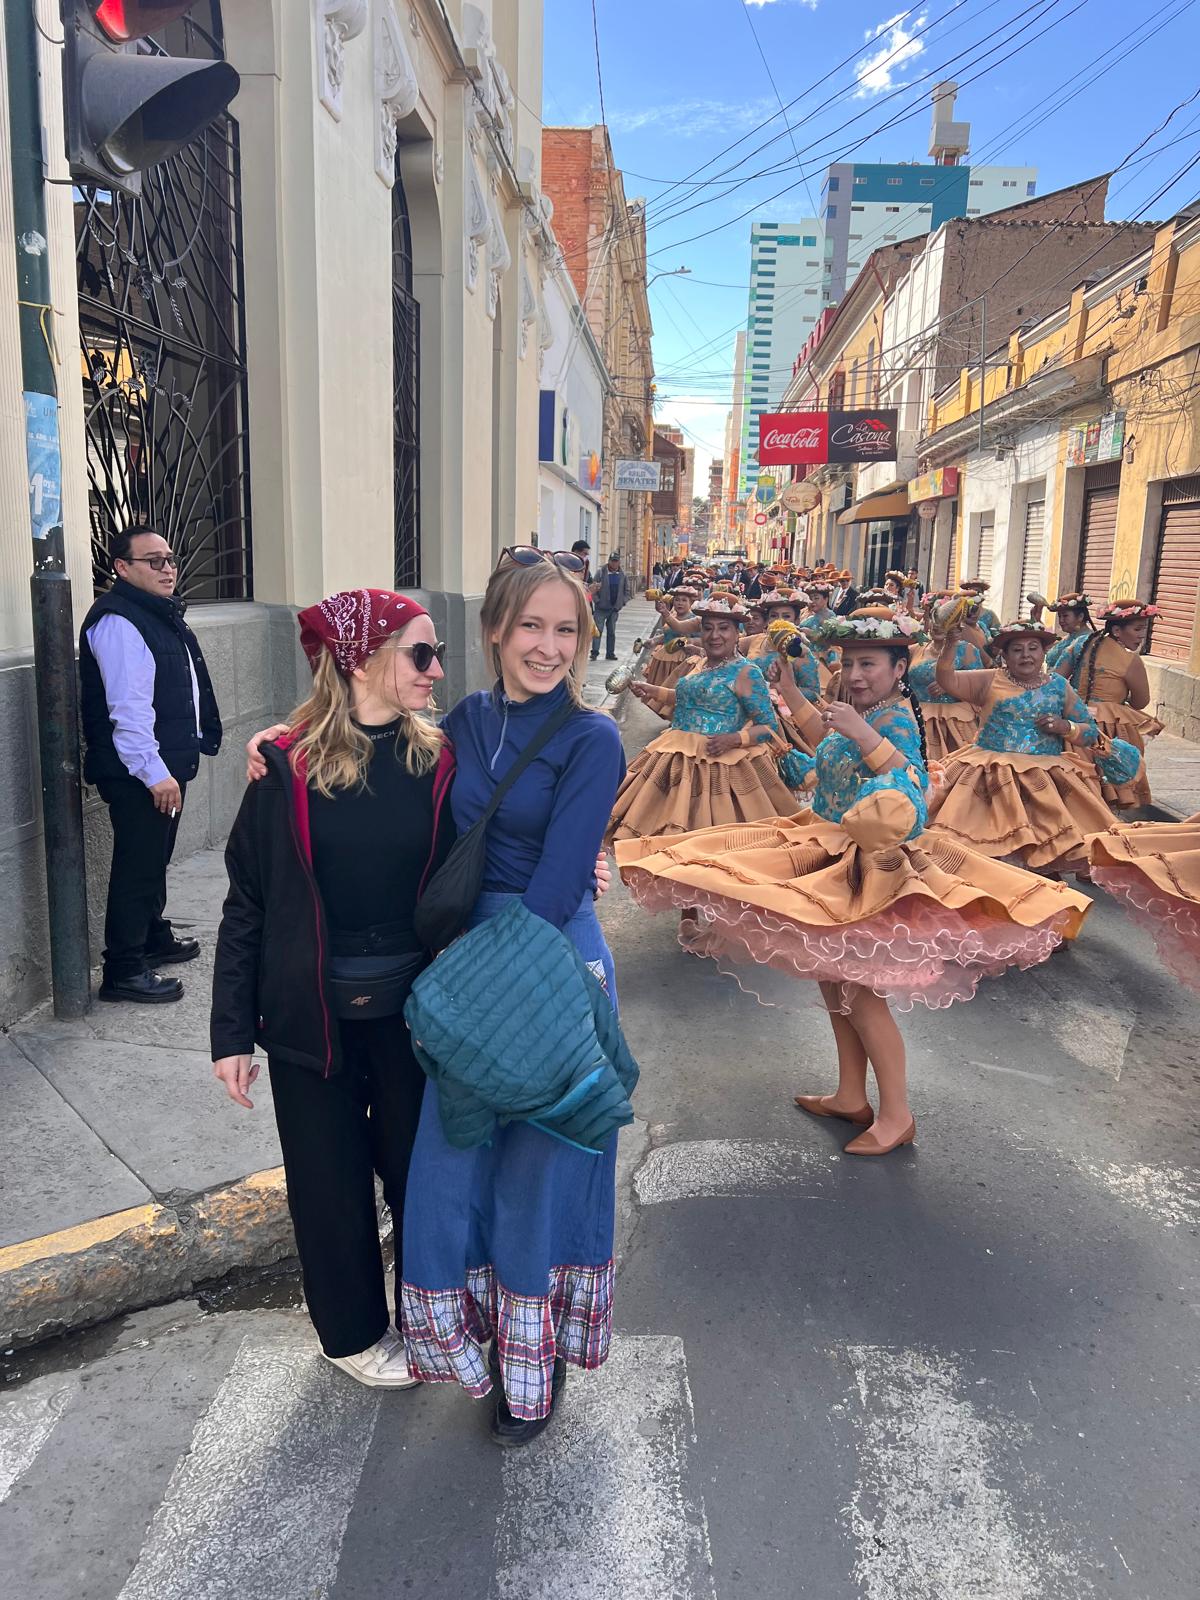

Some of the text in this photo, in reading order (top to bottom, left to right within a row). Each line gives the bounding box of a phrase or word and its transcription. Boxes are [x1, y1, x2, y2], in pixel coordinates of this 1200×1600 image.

[764, 428, 822, 449] Coca-Cola
[831, 424, 892, 445] Casona
[350, 995, 372, 1007] 4F
